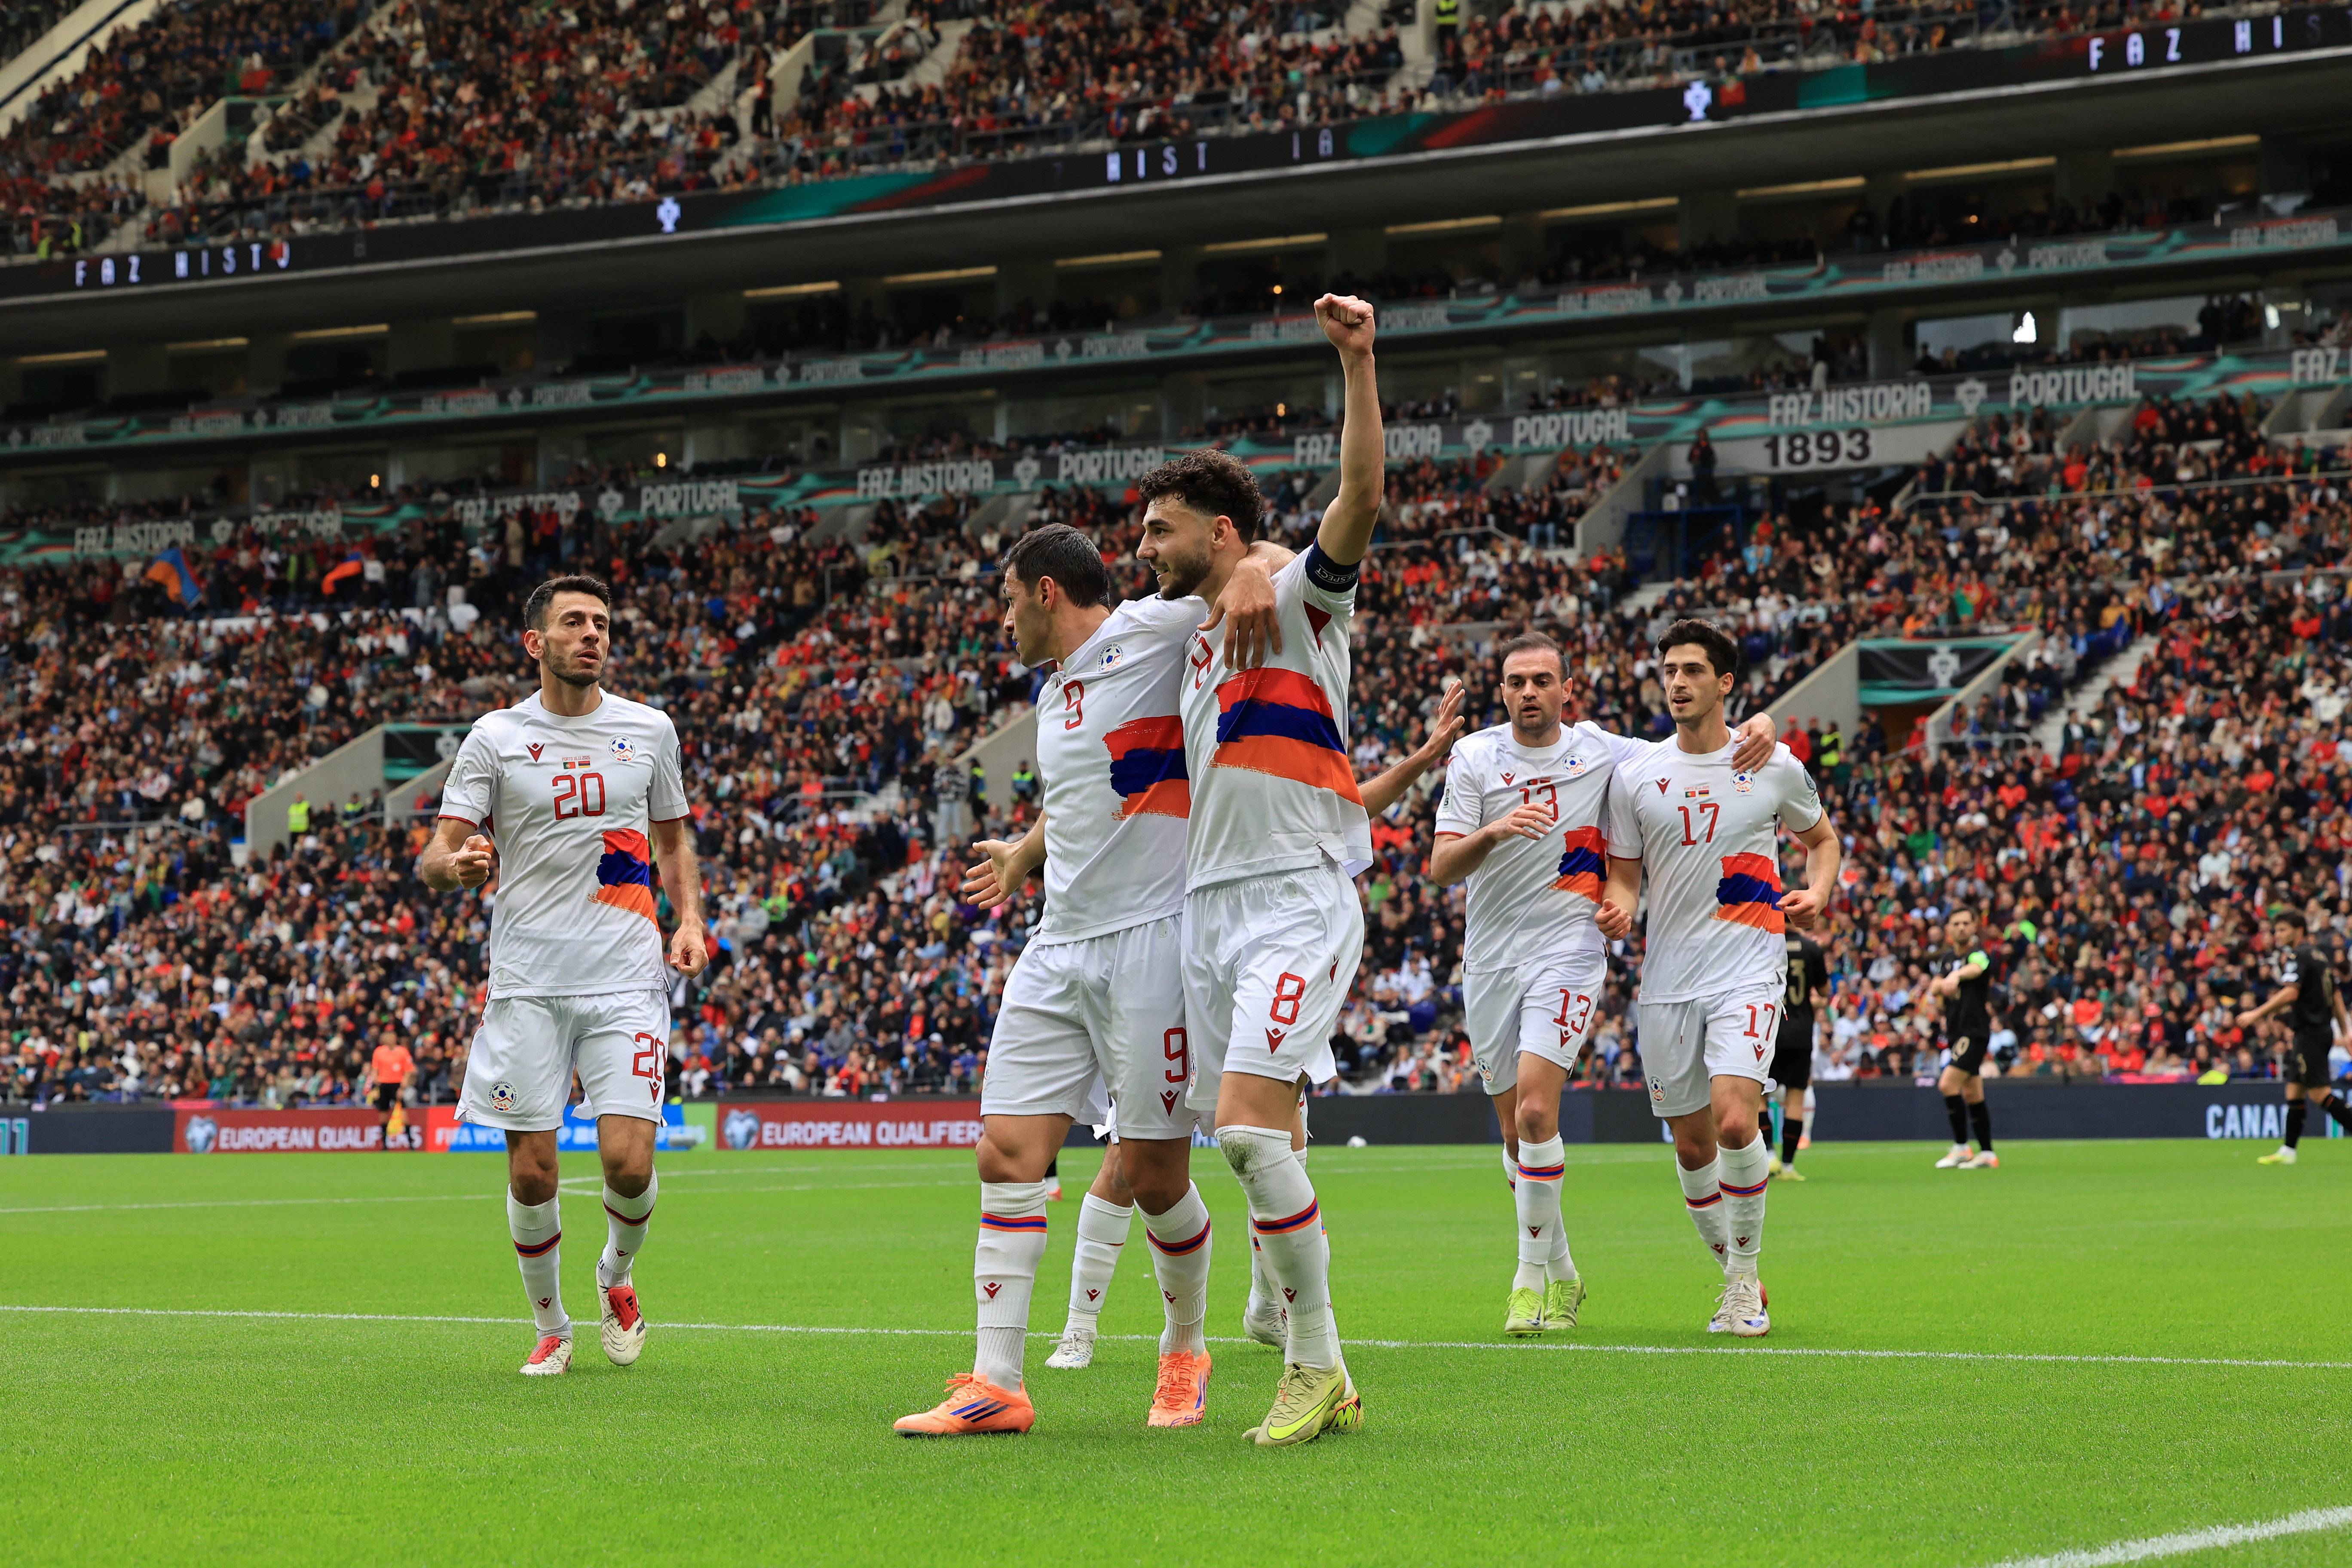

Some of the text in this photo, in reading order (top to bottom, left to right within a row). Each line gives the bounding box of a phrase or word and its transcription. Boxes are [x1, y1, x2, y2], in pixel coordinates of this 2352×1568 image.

[2089, 28, 2182, 71] FAZ
[75, 254, 141, 287] FAZ
[2291, 347, 2342, 384] FAZ
[1769, 393, 1813, 427] FAZ
[2009, 364, 2142, 408] PORTUGAL
[1293, 433, 1335, 466] FAZ
[1512, 409, 1633, 450] PORTUGAL
[1764, 430, 1871, 466] 1893
[640, 480, 743, 515] PORTUGAL
[858, 469, 895, 498] FAZ
[1098, 643, 1112, 665] FEDERATION
[1063, 680, 1084, 730] 9
[609, 735, 629, 743] FEDERATION
[551, 772, 606, 821] 20
[1678, 802, 1720, 846] 17
[1269, 971, 1306, 1026] 8
[1553, 988, 1592, 1035] 13
[1743, 1003, 1776, 1042] 17
[632, 1032, 667, 1083] 20
[1164, 1026, 1188, 1084] 9
[509, 1093, 517, 1109] ARMENIA
[219, 1126, 313, 1150] EUROPEAN
[762, 1121, 871, 1146] EUROPEAN
[1170, 1410, 1204, 1427] F50
